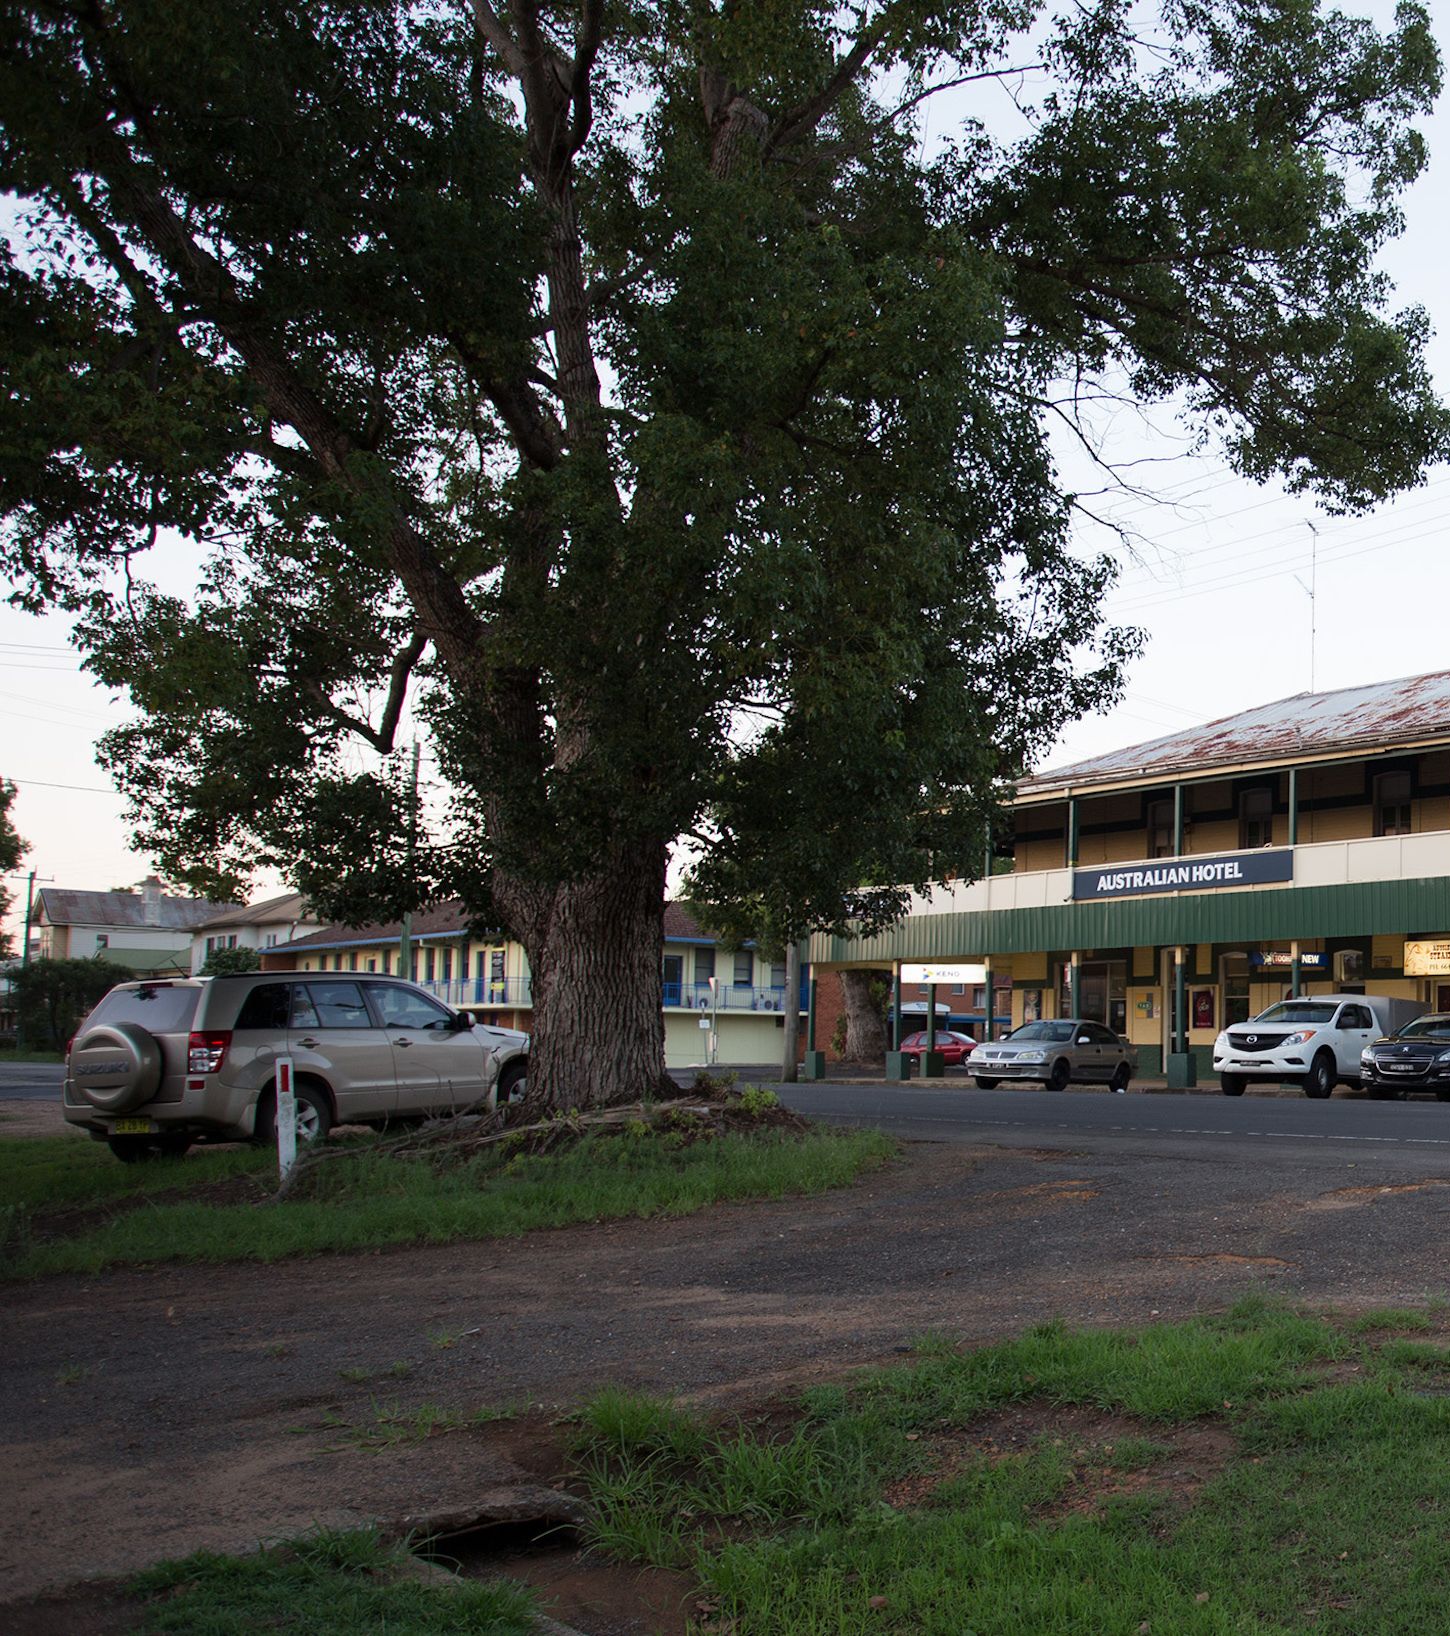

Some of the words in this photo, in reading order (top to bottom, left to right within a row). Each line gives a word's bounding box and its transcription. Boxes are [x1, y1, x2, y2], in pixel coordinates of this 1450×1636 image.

[1096, 866, 1190, 891] AUSTRALIAN
[1192, 861, 1243, 882] HOTEL
[1301, 954, 1320, 964] NEW
[75, 1061, 129, 1076] SUZUKI
